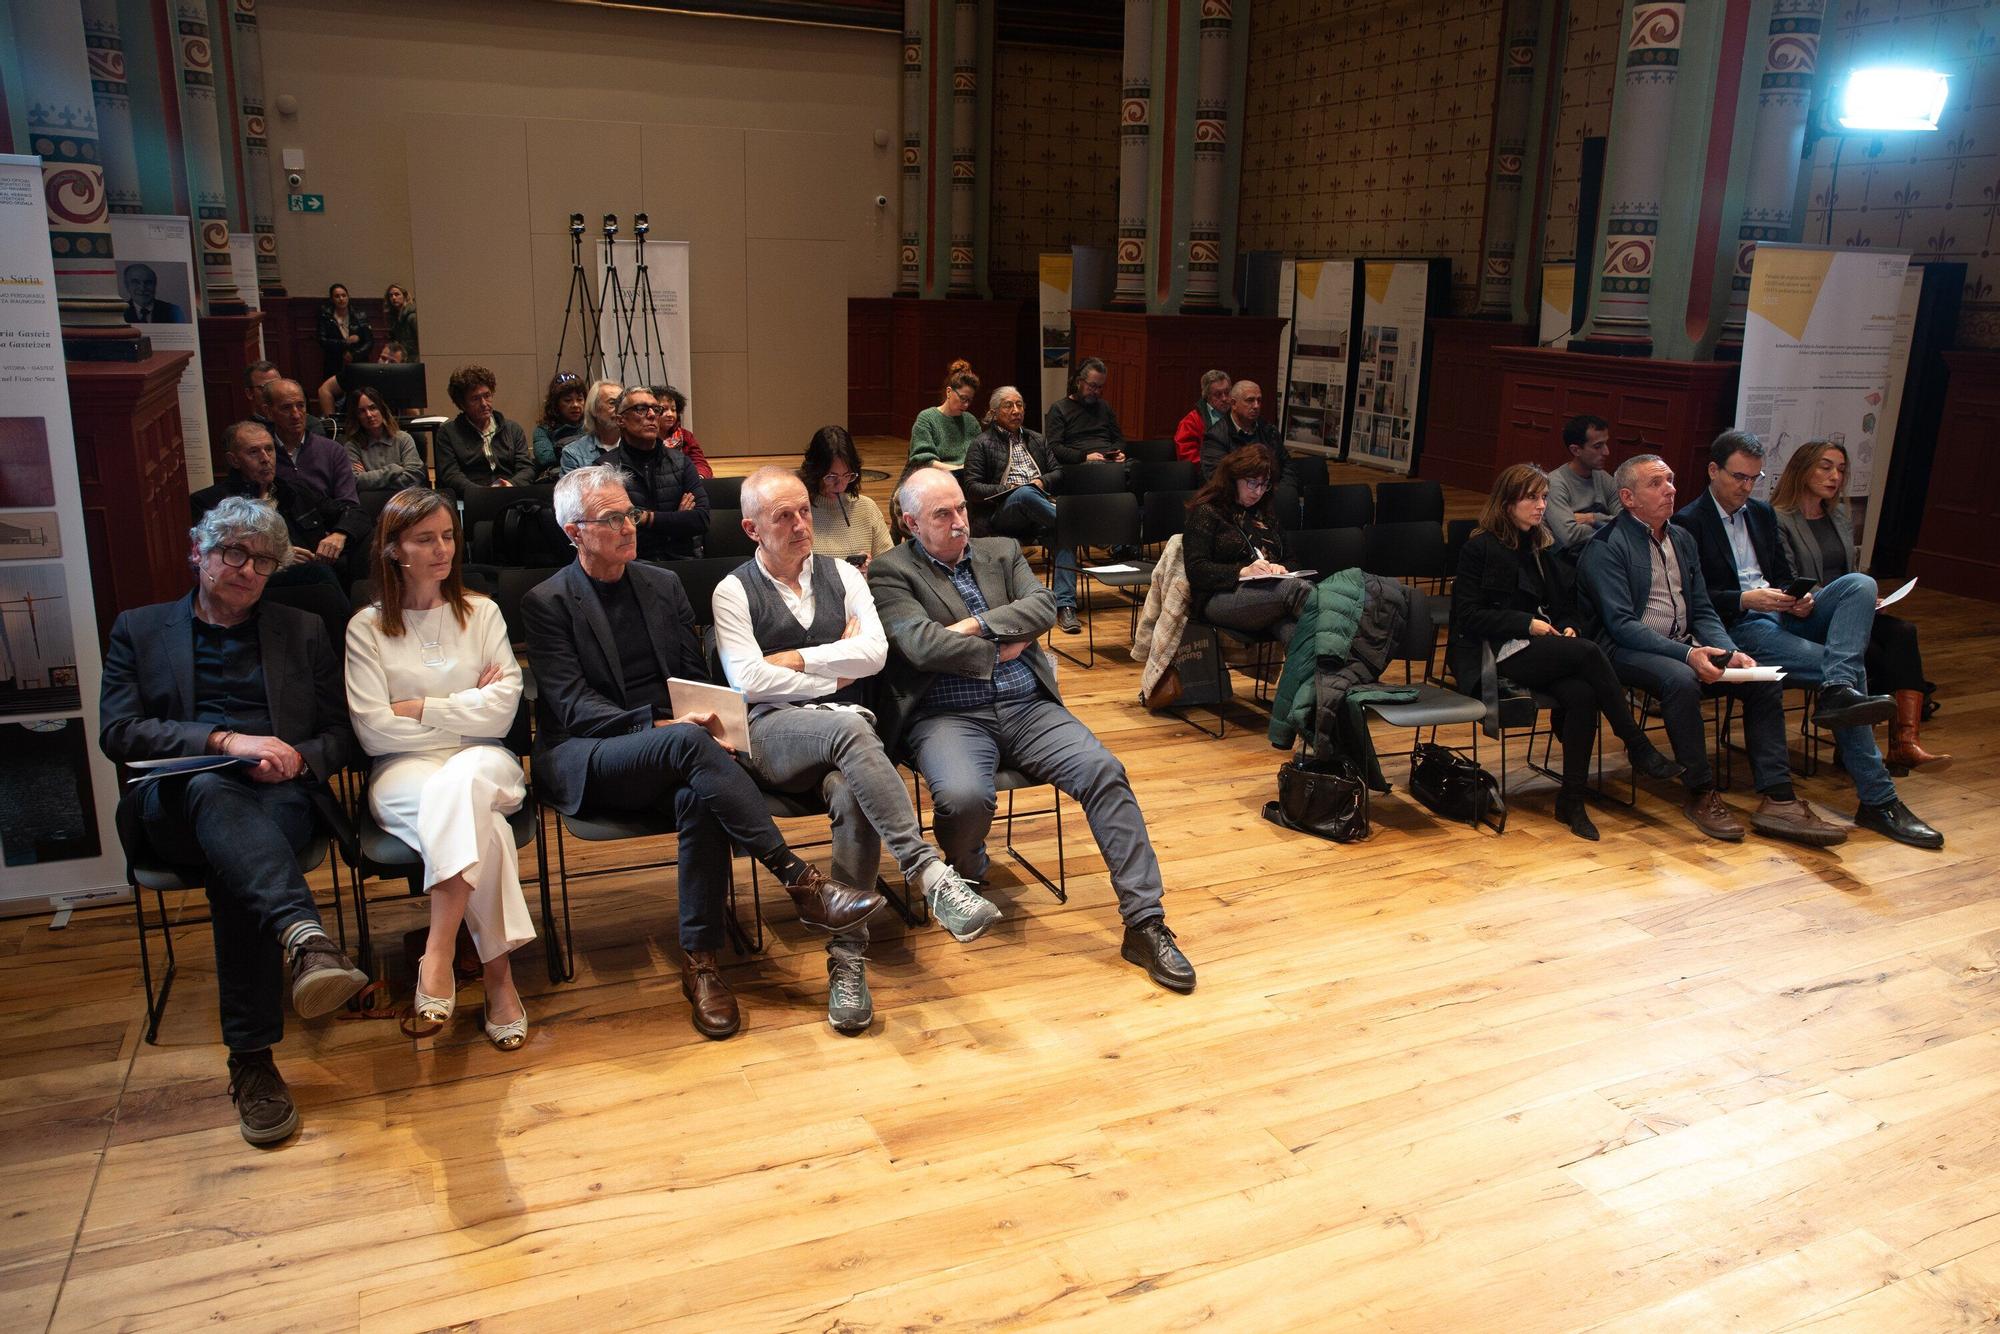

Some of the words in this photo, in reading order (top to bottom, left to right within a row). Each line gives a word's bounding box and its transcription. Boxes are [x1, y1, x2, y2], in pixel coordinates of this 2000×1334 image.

[11, 275, 40, 285] Saria
[18, 329, 50, 338] Gasteiz
[1193, 639, 1209, 649] Hill
